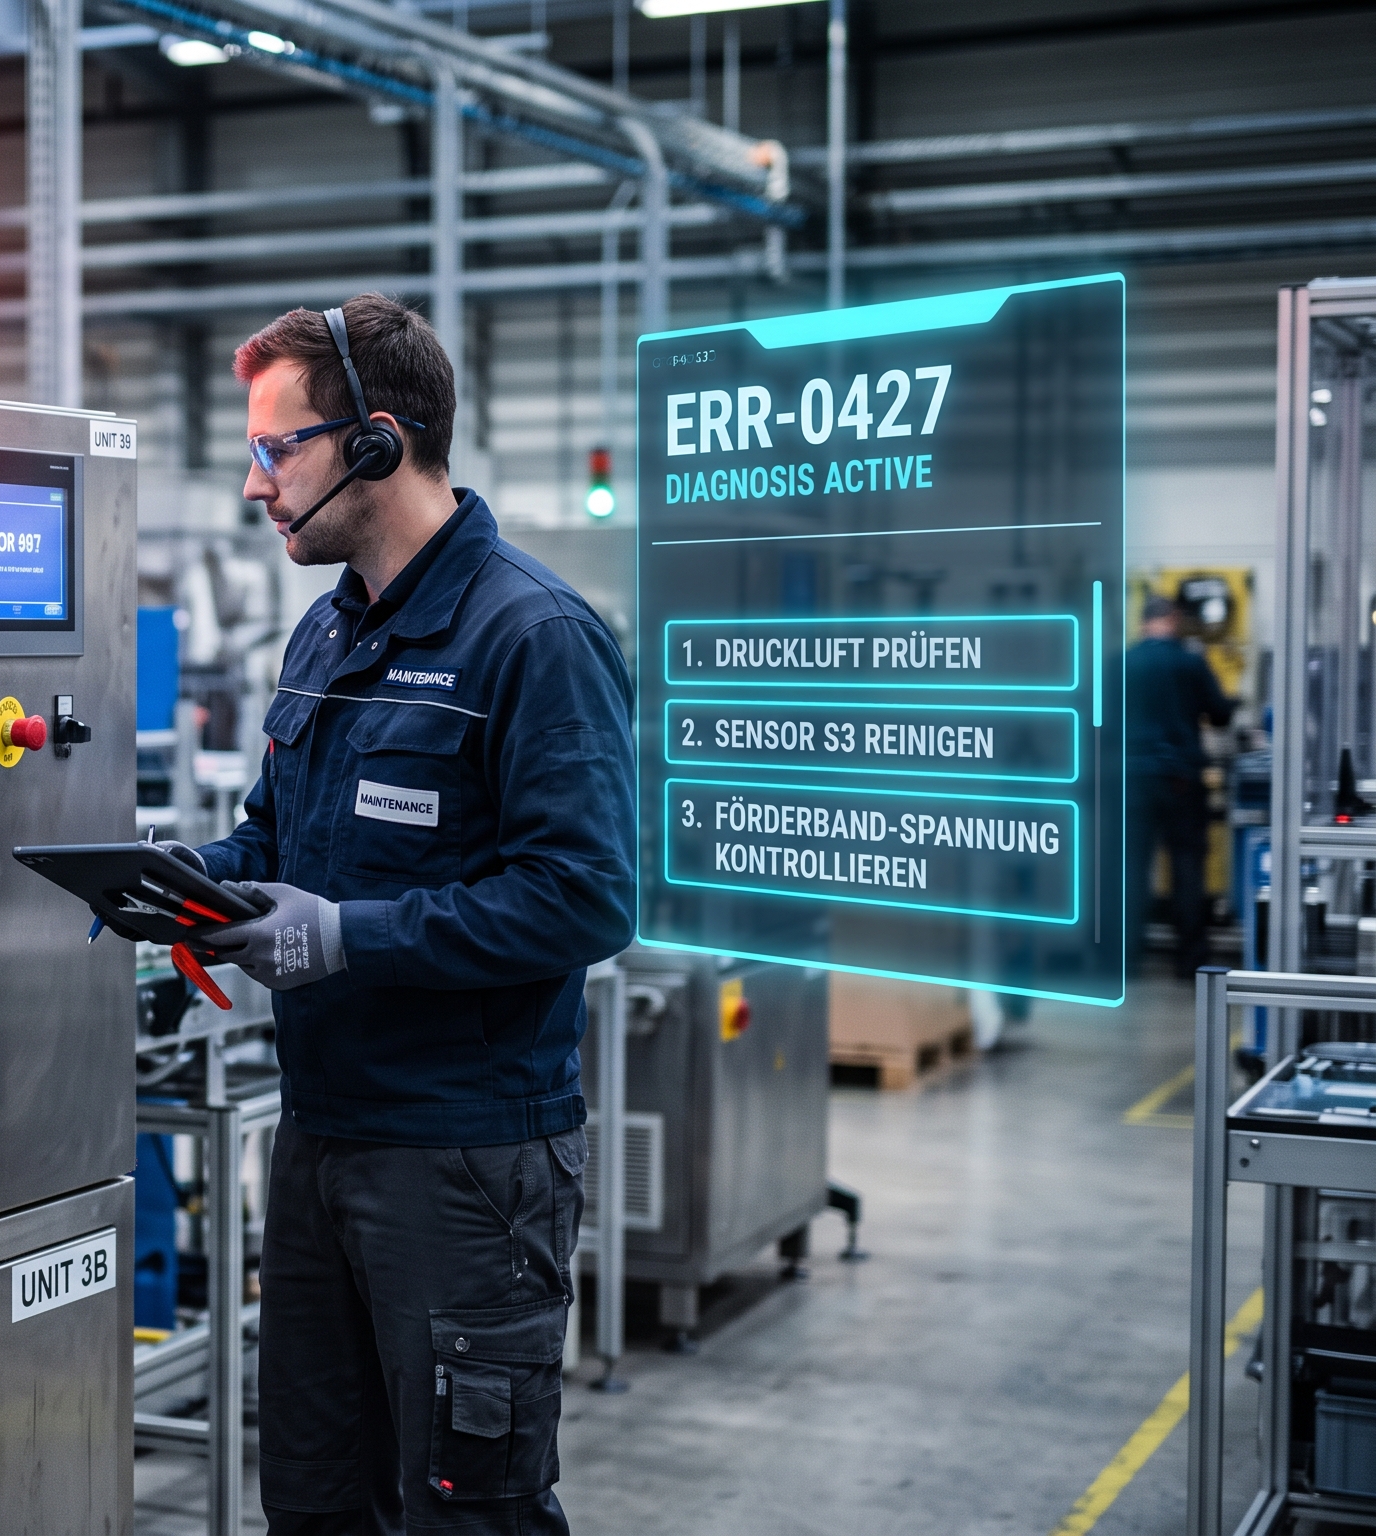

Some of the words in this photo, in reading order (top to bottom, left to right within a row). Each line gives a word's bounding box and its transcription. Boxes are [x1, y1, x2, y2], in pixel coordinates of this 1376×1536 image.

[667, 364, 952, 456] ERR-0427
[94, 431, 117, 448] UNIT
[120, 433, 131, 449] 39
[666, 463, 815, 504] DIAGNOSIS
[823, 454, 933, 494] ACTIVE
[682, 638, 703, 668] 1.
[715, 638, 864, 669] DRUCKLUFT
[872, 630, 982, 669] PRÜFEN
[681, 718, 703, 747] 2.
[715, 718, 815, 751] SENSOR
[824, 722, 856, 753] S3
[864, 723, 994, 759] REINIGEN
[360, 793, 434, 814] MAINTENANCE
[681, 799, 703, 829] 3.
[715, 795, 1060, 855] FÖRDERBAND-SPANNUNG
[715, 842, 927, 889] KONTROLLIEREN
[22, 1258, 74, 1307] UNIT
[82, 1249, 108, 1287] 3B
